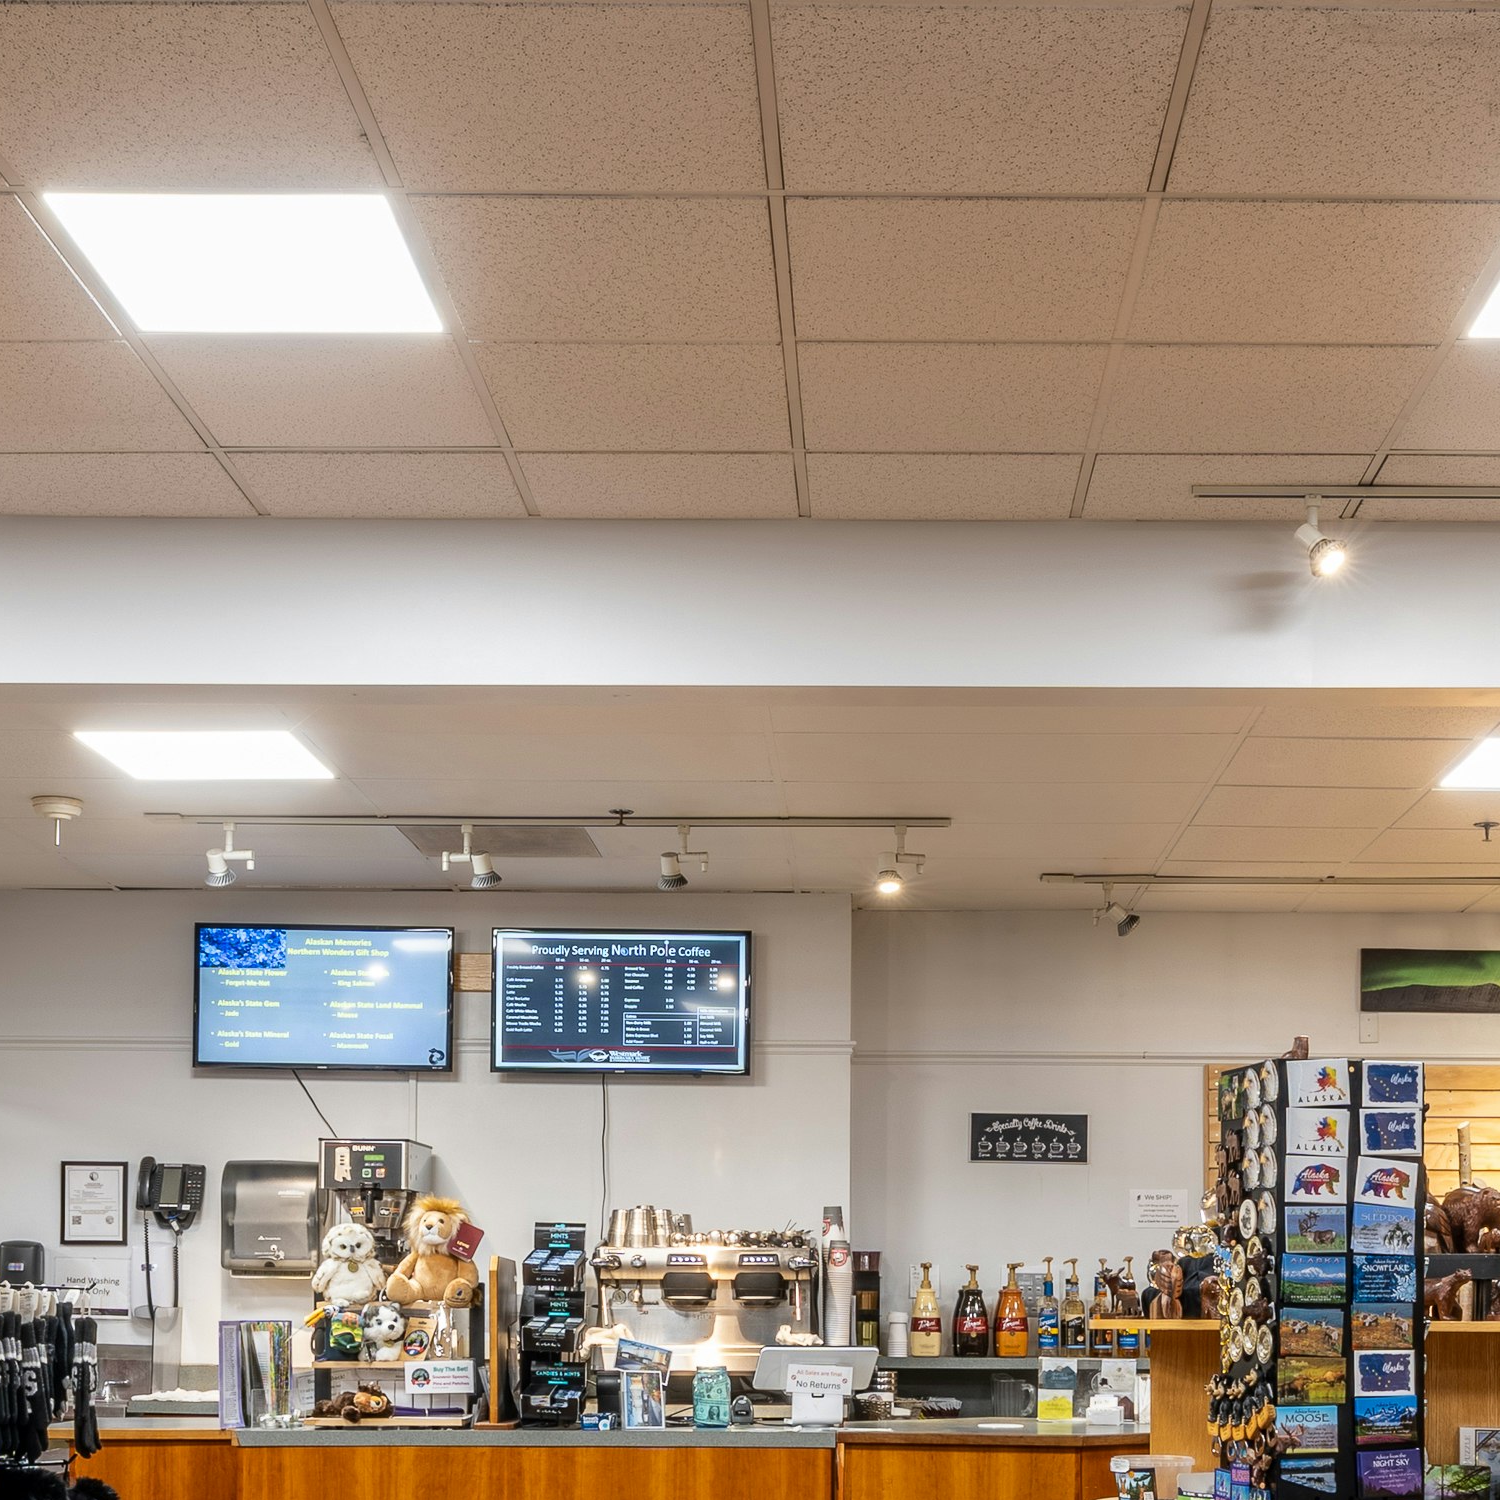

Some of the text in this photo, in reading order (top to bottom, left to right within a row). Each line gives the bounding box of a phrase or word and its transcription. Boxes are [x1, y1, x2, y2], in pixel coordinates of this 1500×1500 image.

[305, 938, 372, 947] Alaskan Memories
[288, 948, 388, 958] Northern Wonders Gift Shop
[532, 943, 710, 958] Proudly Serving North Pole Coffee
[1390, 1072, 1412, 1085] Alaska
[1298, 1094, 1342, 1103] ALASKA
[990, 1118, 1068, 1133] Specialty Coffee Drinks
[1300, 1168, 1330, 1180] Alaska
[1372, 1172, 1400, 1184] Alaska
[1361, 1264, 1410, 1272] SNOWFLAKE
[66, 1276, 120, 1286] Hand Washing
[93, 1288, 110, 1296] Only
[796, 1380, 840, 1390] No Returns
[1286, 1413, 1330, 1424] MOOSE
[1373, 1458, 1410, 1468] NIGHT SKY
